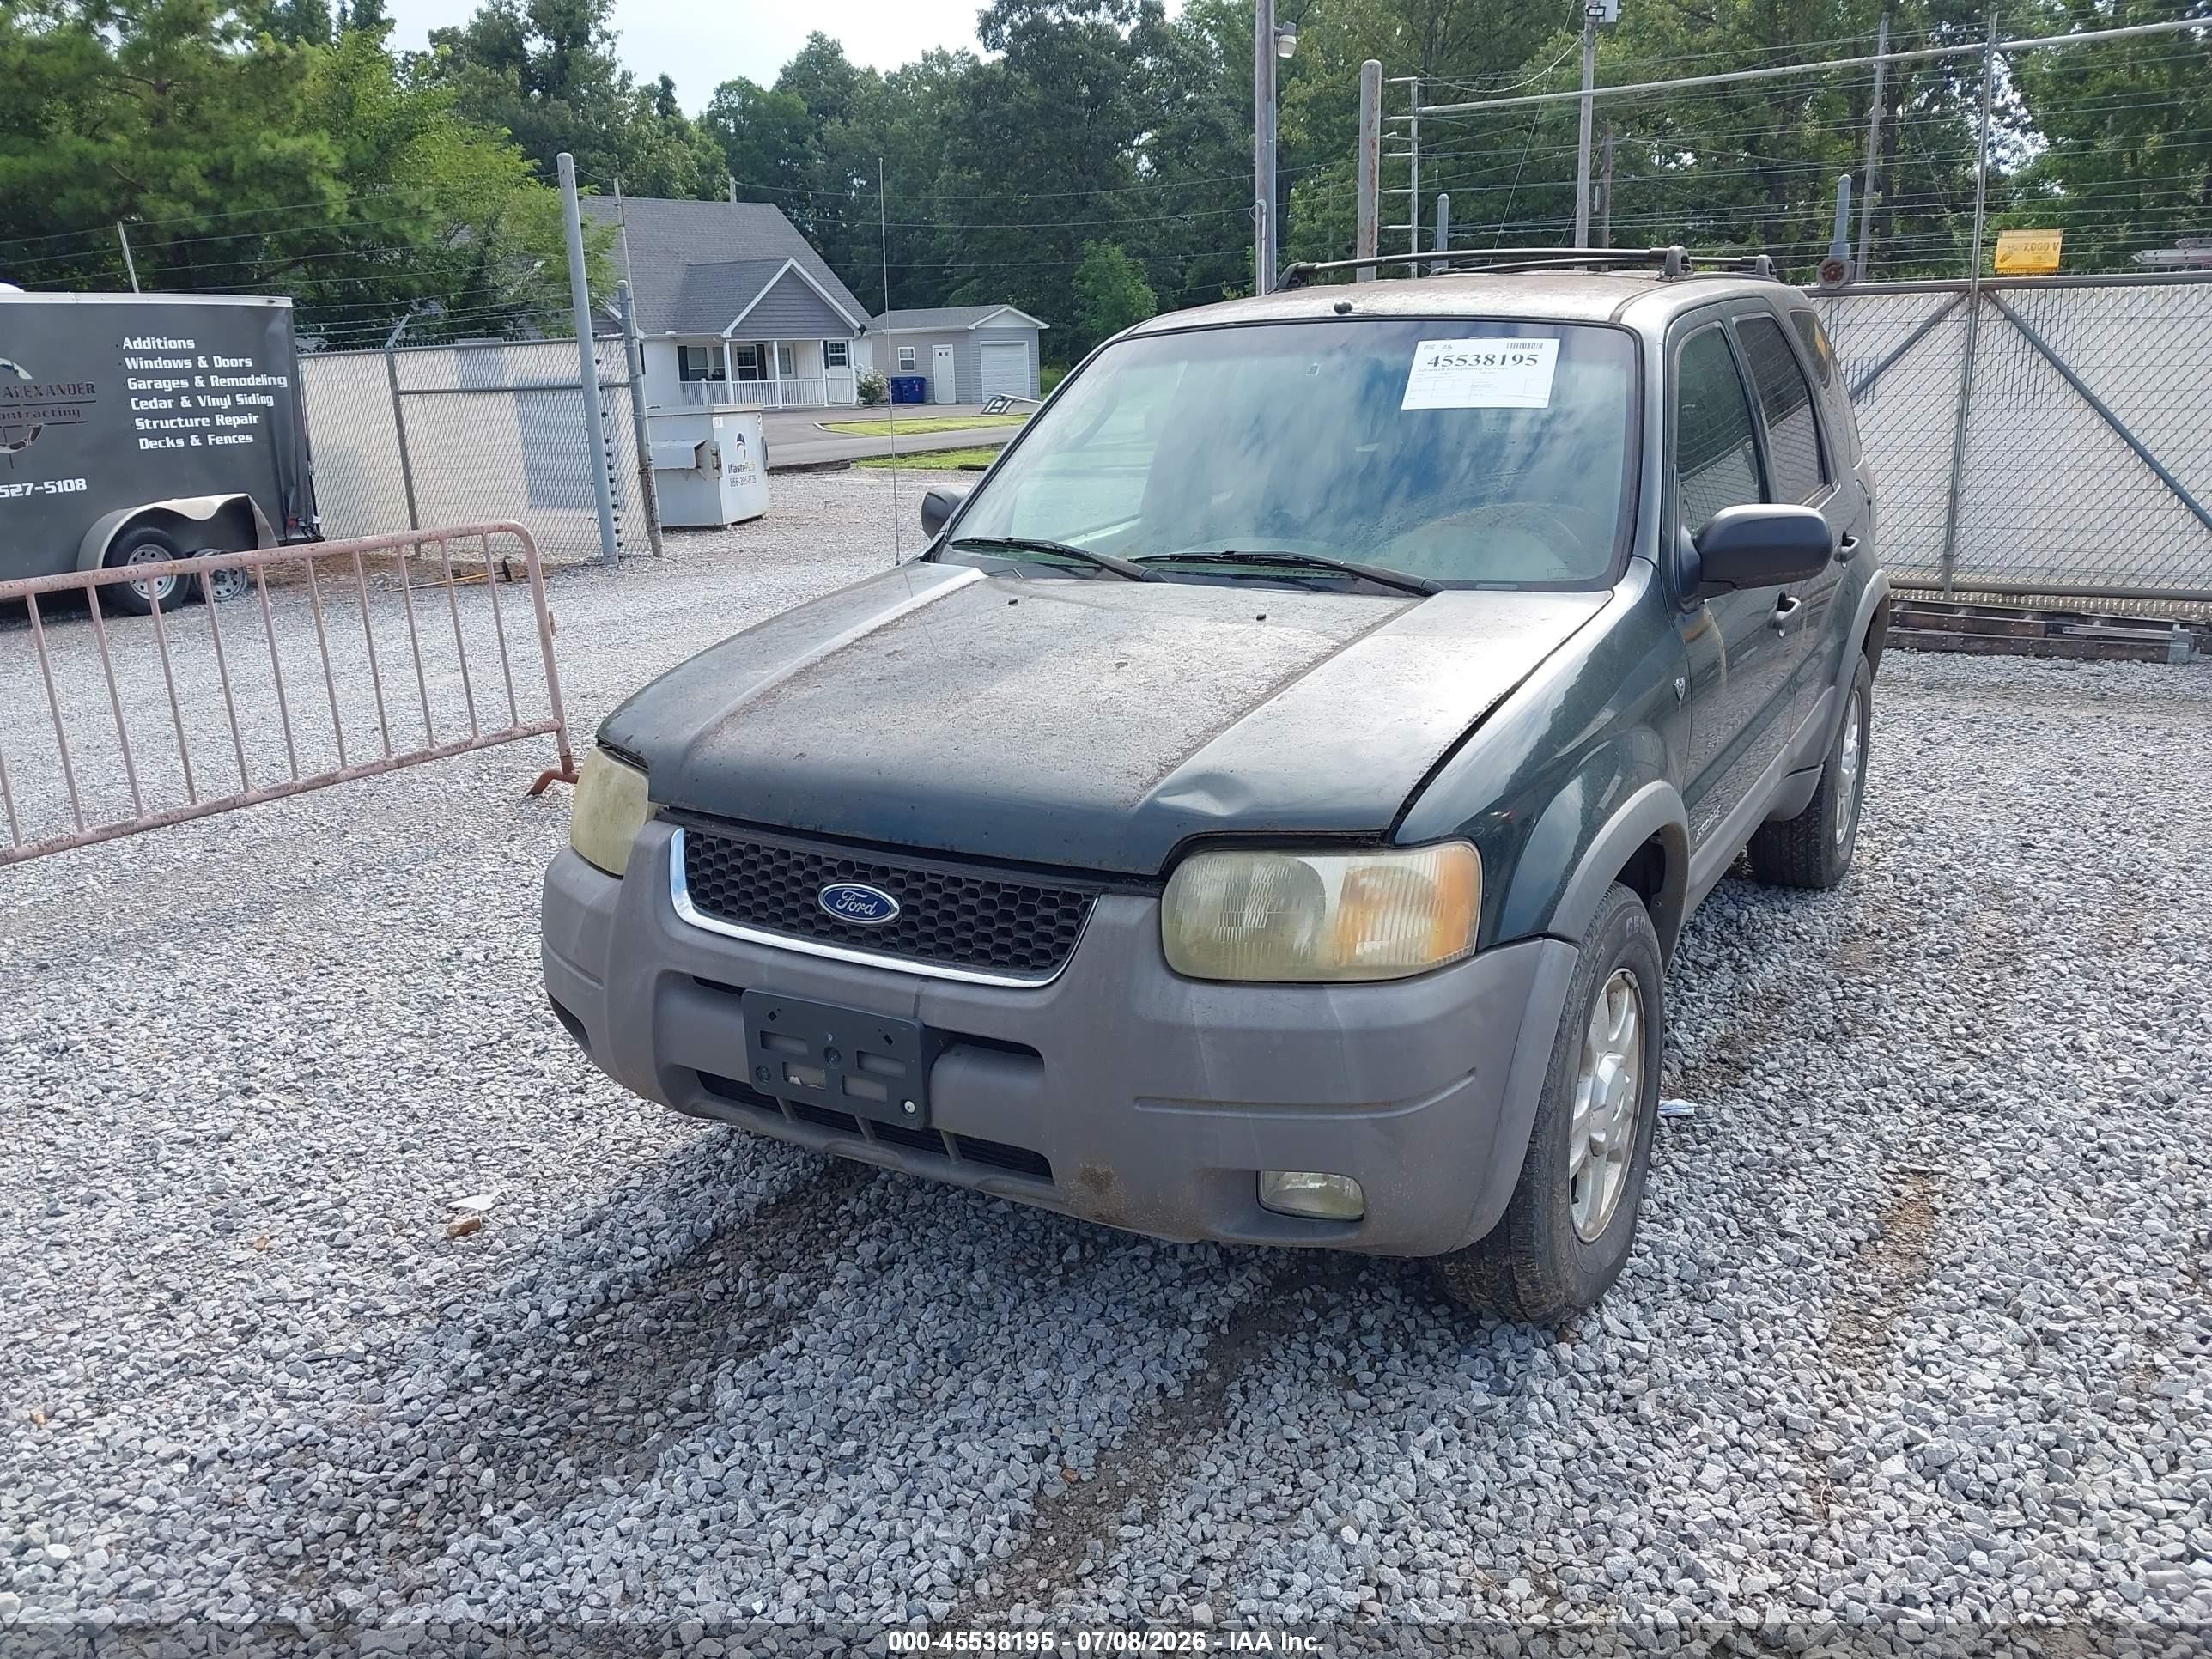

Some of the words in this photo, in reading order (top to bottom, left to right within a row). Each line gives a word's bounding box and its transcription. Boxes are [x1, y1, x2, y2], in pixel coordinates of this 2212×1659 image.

[122, 337, 196, 349] Additions
[125, 357, 192, 369] Windows
[198, 356, 209, 368] &
[213, 356, 252, 368] Doors
[1427, 354, 1538, 368] 45538195
[3, 383, 96, 398] ALEXANDER
[127, 377, 189, 392] Garages
[194, 375, 205, 387] &
[210, 374, 287, 388] Remodeling
[131, 397, 173, 410] Cedar
[180, 395, 192, 408] &
[197, 394, 232, 410] Vinyl
[235, 392, 275, 407] Siding
[135, 417, 210, 430] Structure
[215, 412, 259, 428] Repair
[138, 437, 185, 450] Decks
[190, 434, 202, 447] &
[207, 434, 253, 446] Fences
[0, 478, 87, 498] 527-5108
[836, 890, 878, 915] Ford
